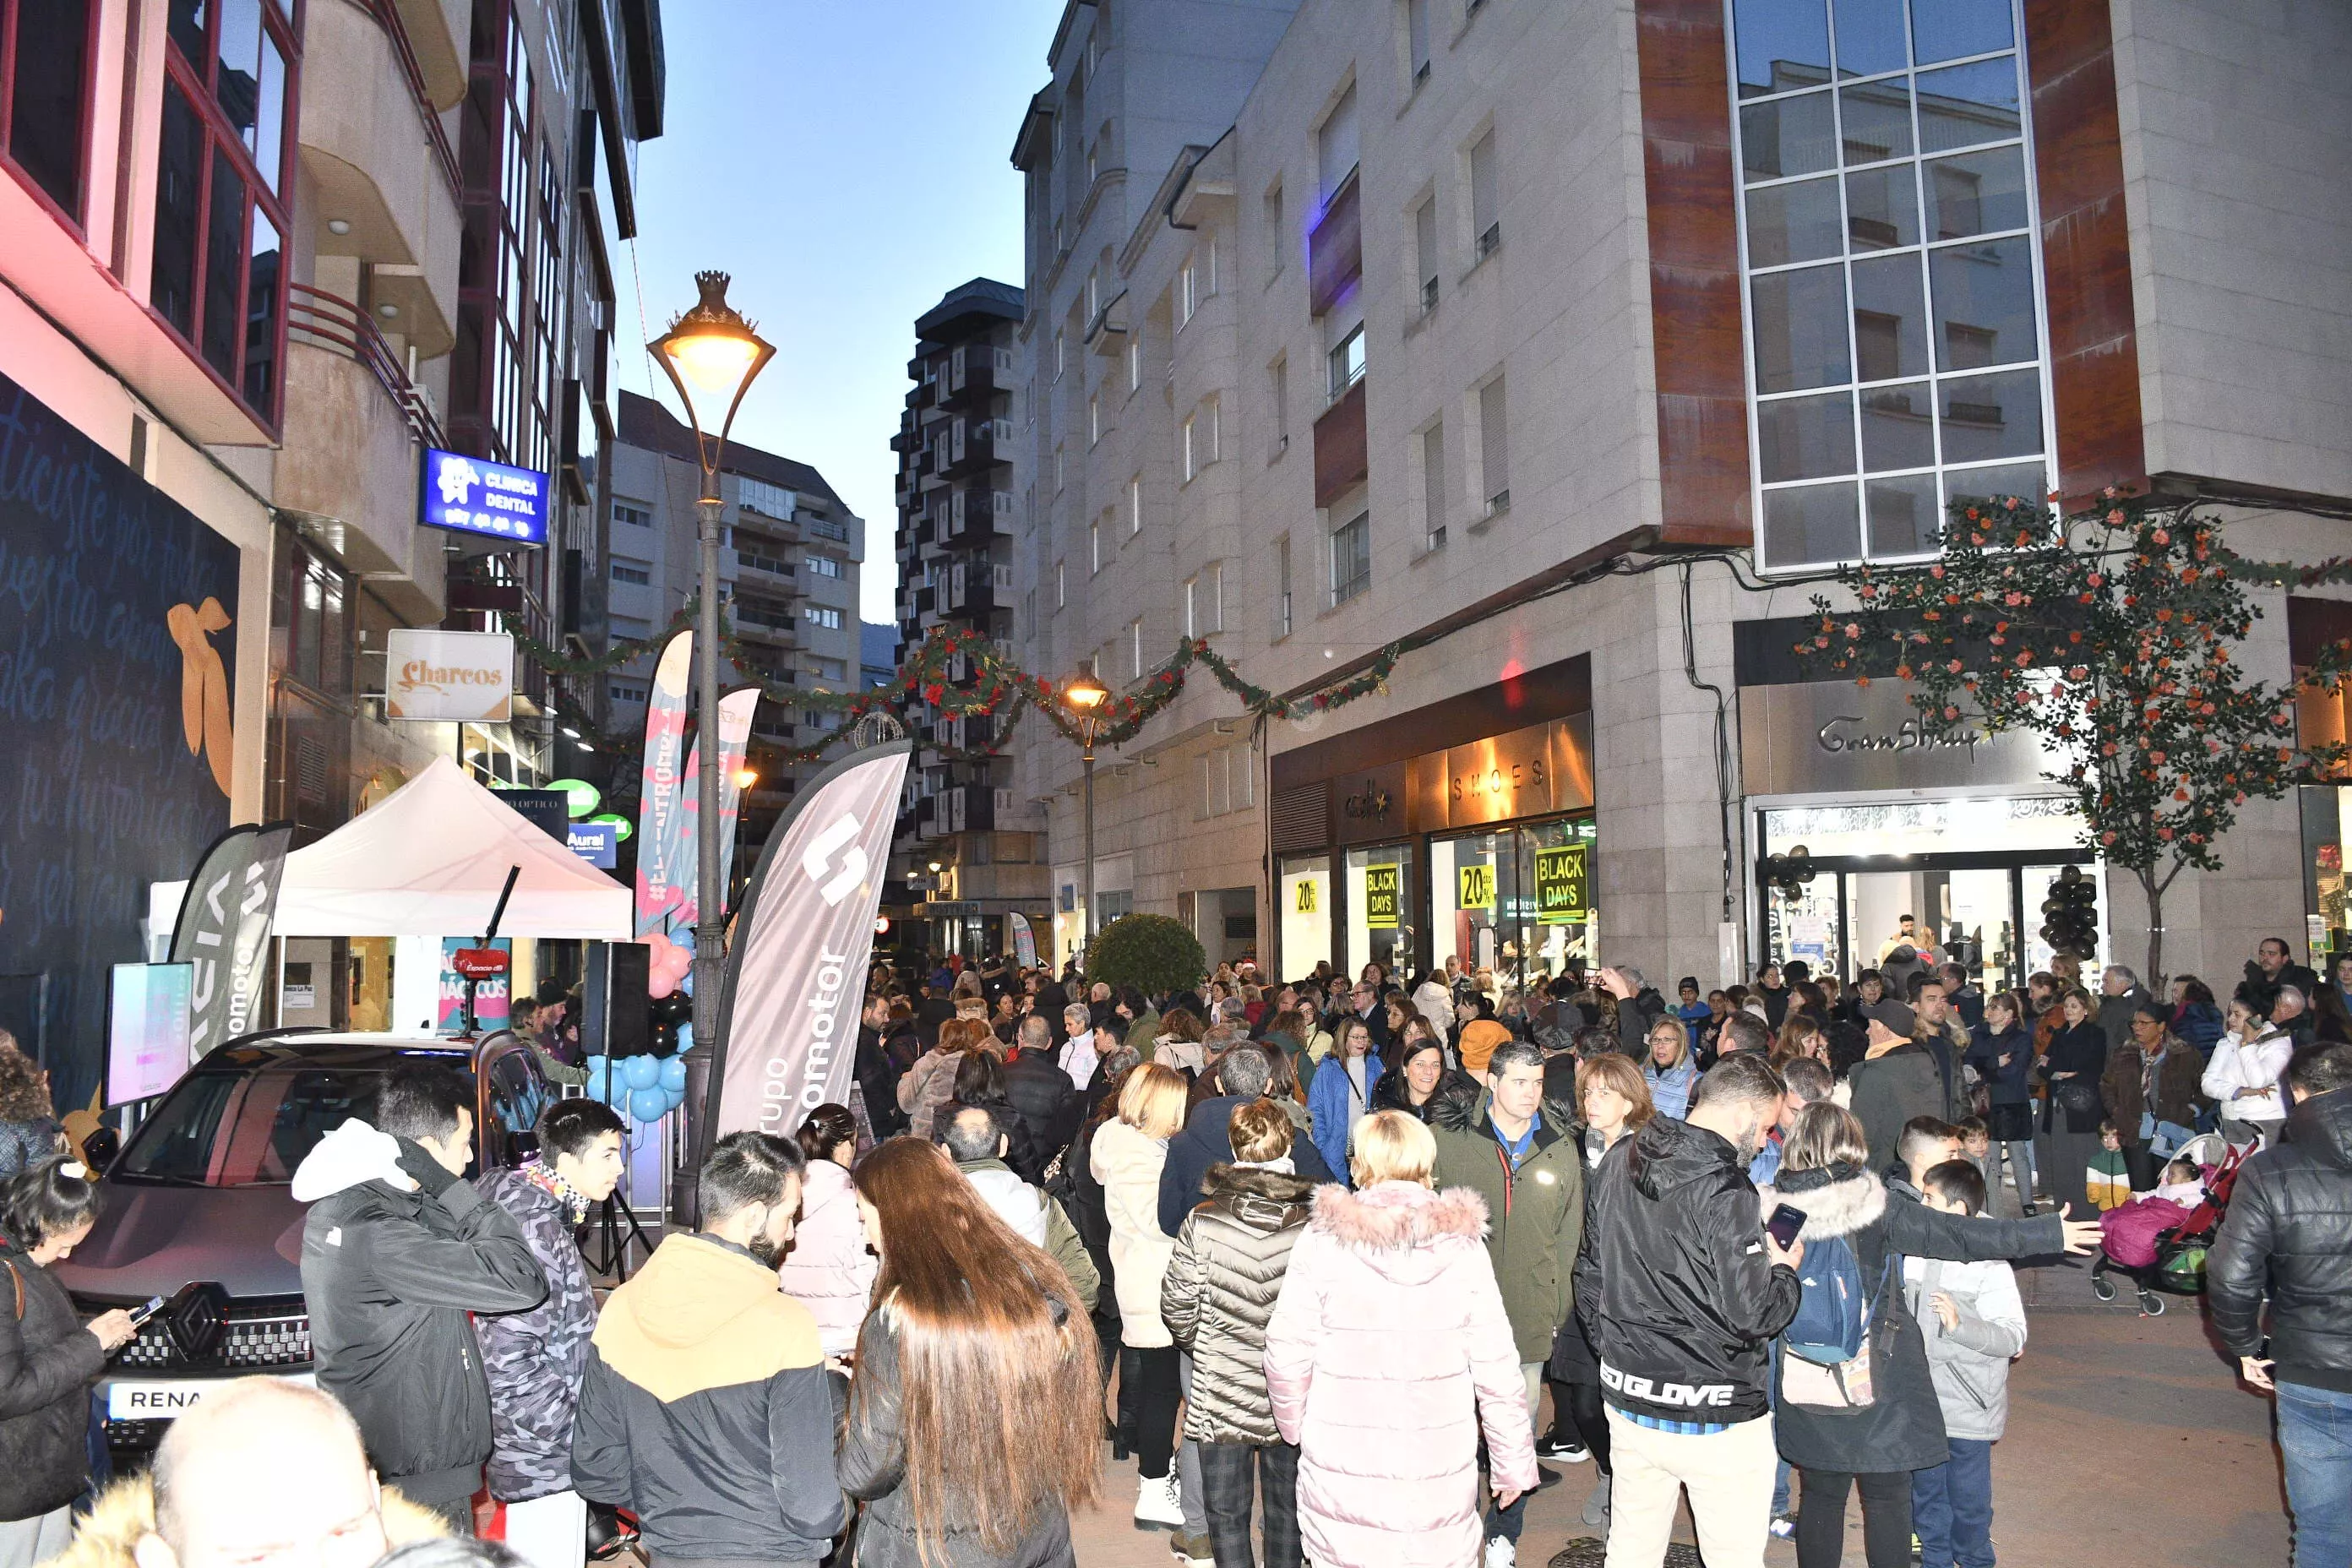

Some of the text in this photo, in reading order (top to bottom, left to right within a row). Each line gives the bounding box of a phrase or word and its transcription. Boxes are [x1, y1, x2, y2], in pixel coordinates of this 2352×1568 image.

[485, 493, 536, 515] DENTAL
[397, 660, 502, 692] Charcos
[1454, 760, 1543, 801] SHOES
[567, 832, 605, 847] Aural
[1368, 871, 1396, 892] BLACK
[1539, 854, 1584, 881] BLACK
[1298, 882, 1310, 911] 20
[1463, 868, 1484, 905] 20
[1545, 884, 1577, 907] DAYS
[1371, 895, 1391, 912] DAYS
[227, 937, 255, 1042] omotor
[1623, 1373, 1734, 1407] GLOVE
